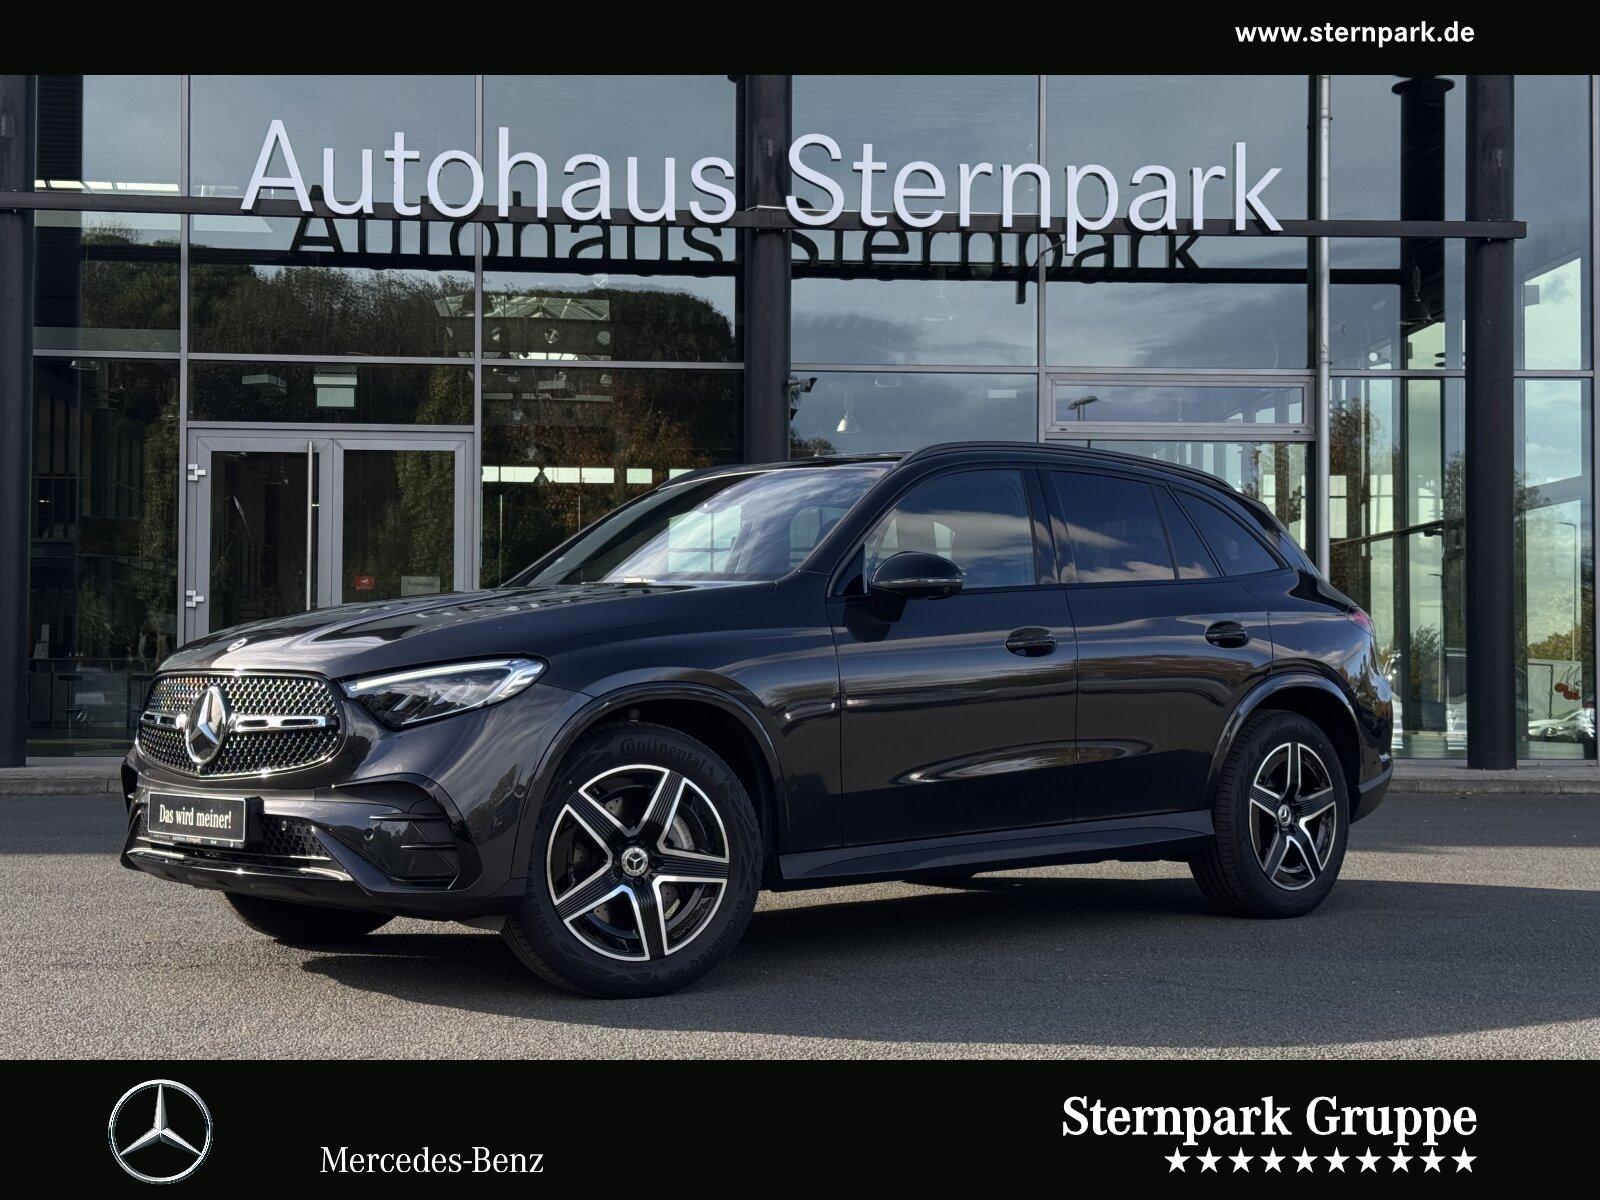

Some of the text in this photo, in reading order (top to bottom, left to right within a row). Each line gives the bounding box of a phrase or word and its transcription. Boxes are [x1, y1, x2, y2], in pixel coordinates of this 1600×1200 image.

[240, 119, 1284, 255] Autohaus Sternpark
[159, 804, 232, 829] Das wird meiner!
